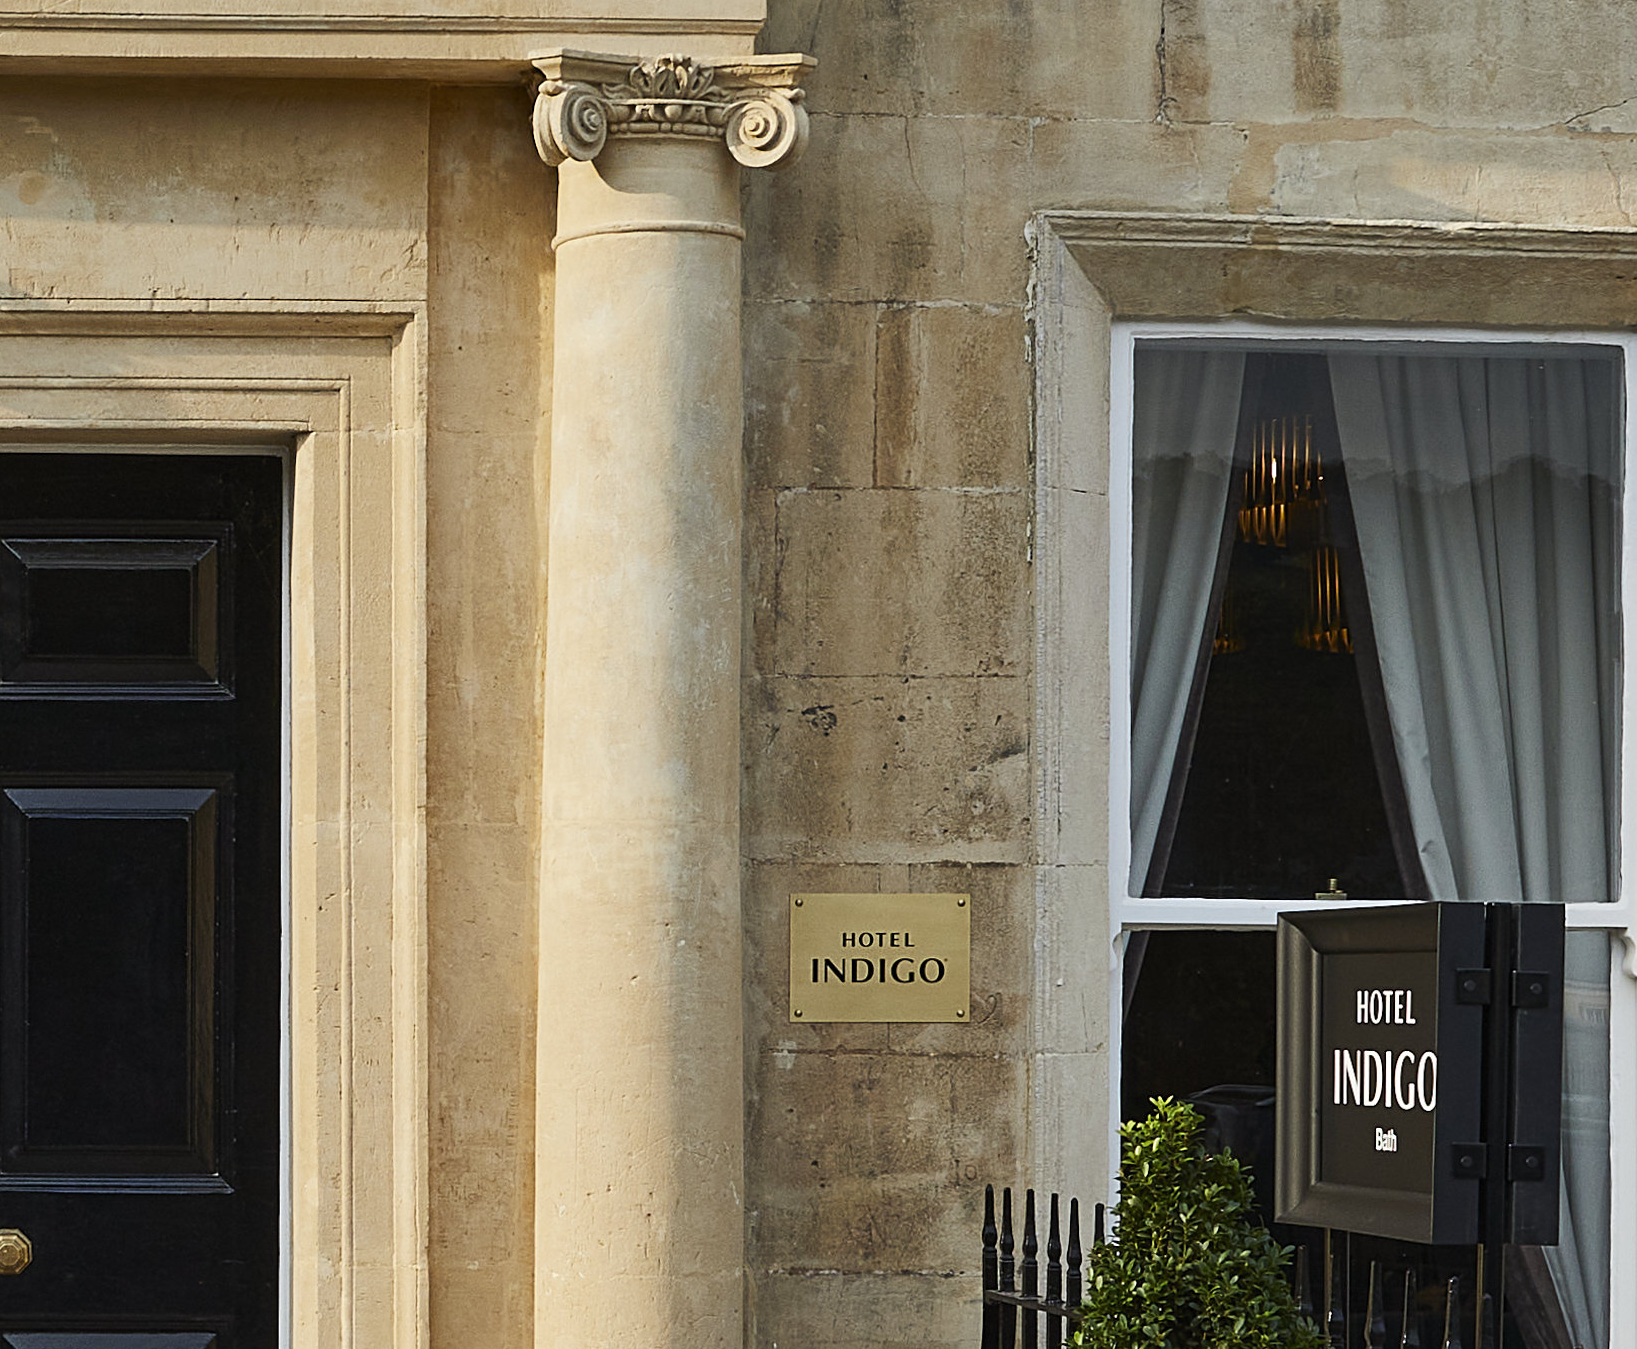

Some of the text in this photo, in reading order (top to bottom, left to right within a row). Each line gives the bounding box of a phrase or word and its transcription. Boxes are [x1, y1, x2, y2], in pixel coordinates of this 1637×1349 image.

[842, 932, 916, 948] HOTEL
[812, 957, 945, 984] INDIGO
[1356, 989, 1416, 1025] HOTEL
[1333, 1049, 1438, 1112] INDIGO
[1375, 1127, 1397, 1152] Bath
